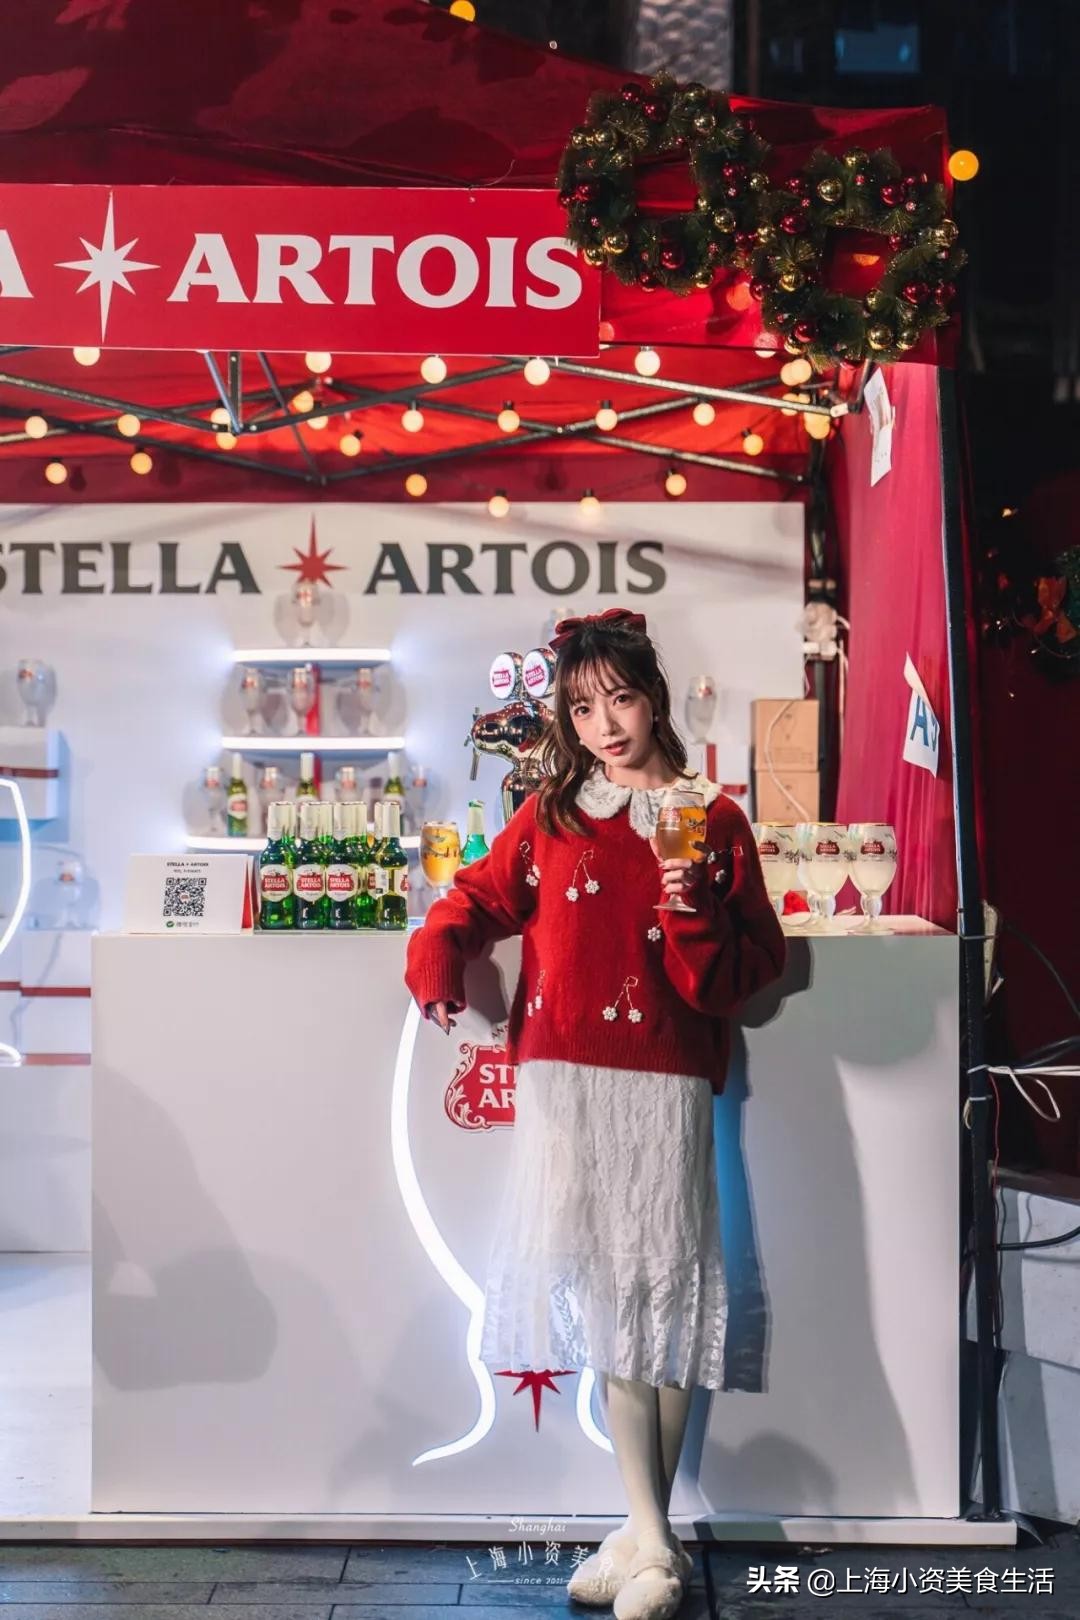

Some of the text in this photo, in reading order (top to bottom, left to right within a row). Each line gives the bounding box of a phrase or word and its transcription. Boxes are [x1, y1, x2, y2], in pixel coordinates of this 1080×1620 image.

[166, 232, 584, 311] ARTOIS
[0, 540, 667, 596] TELLA ARTOIS
